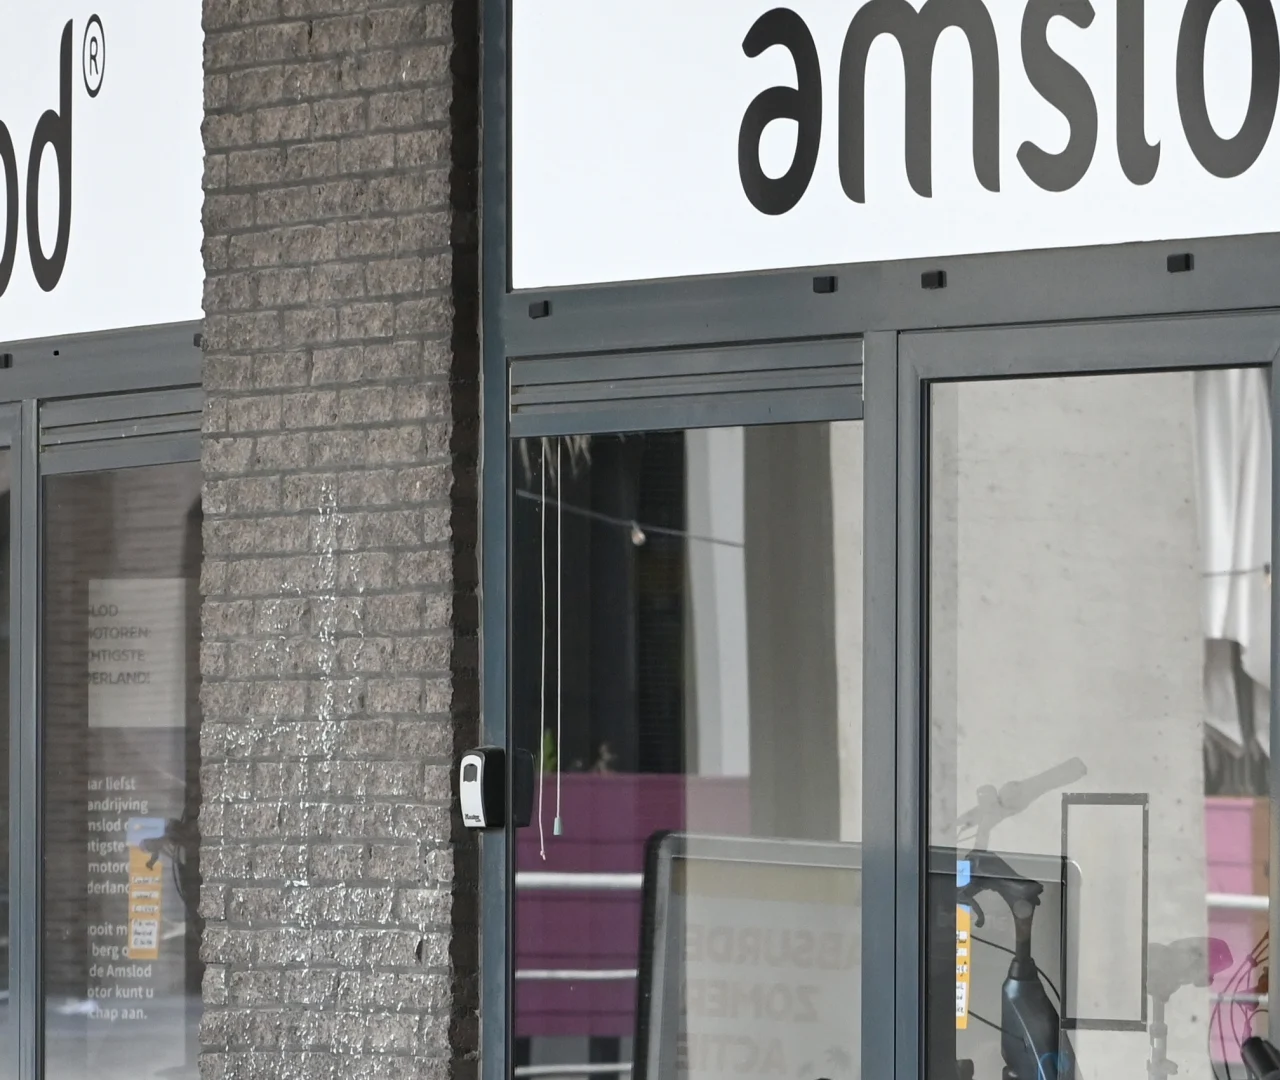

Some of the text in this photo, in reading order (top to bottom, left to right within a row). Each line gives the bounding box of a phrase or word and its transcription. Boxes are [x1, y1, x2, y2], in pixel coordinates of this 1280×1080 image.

[106, 776, 136, 791] liefst
[88, 838, 125, 856] tigste
[88, 922, 113, 936] ooit
[89, 964, 152, 978] de Amslod
[115, 984, 143, 999] kunt
[146, 987, 154, 999] u
